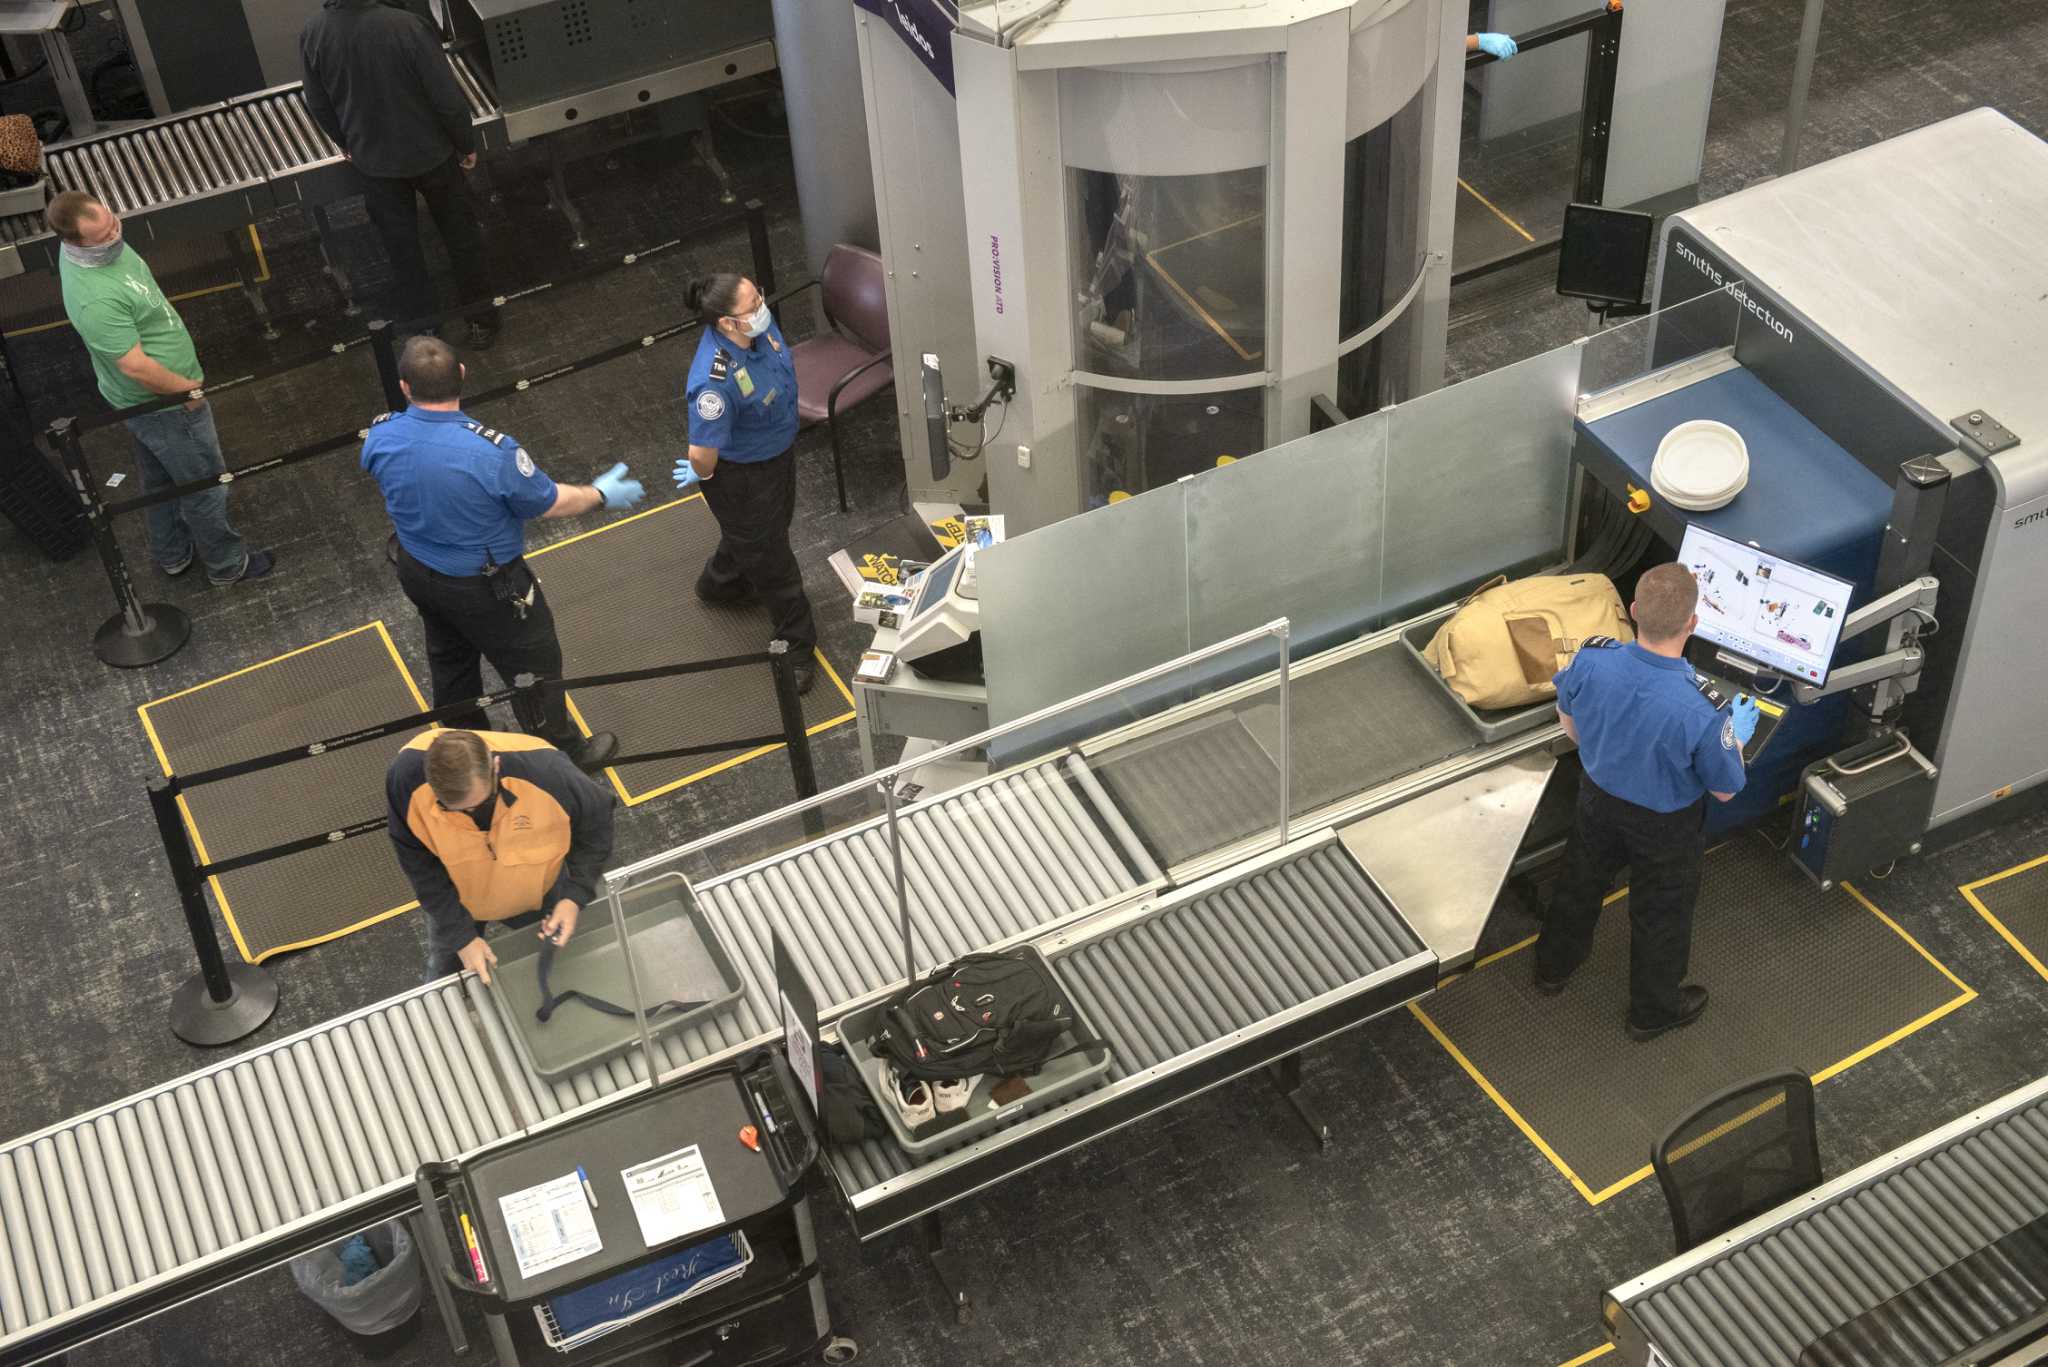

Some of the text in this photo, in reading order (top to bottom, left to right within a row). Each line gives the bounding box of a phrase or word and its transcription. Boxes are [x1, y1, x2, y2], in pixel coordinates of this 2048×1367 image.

[1675, 241, 1793, 344] smiths detection
[2013, 507, 2048, 529] smi
